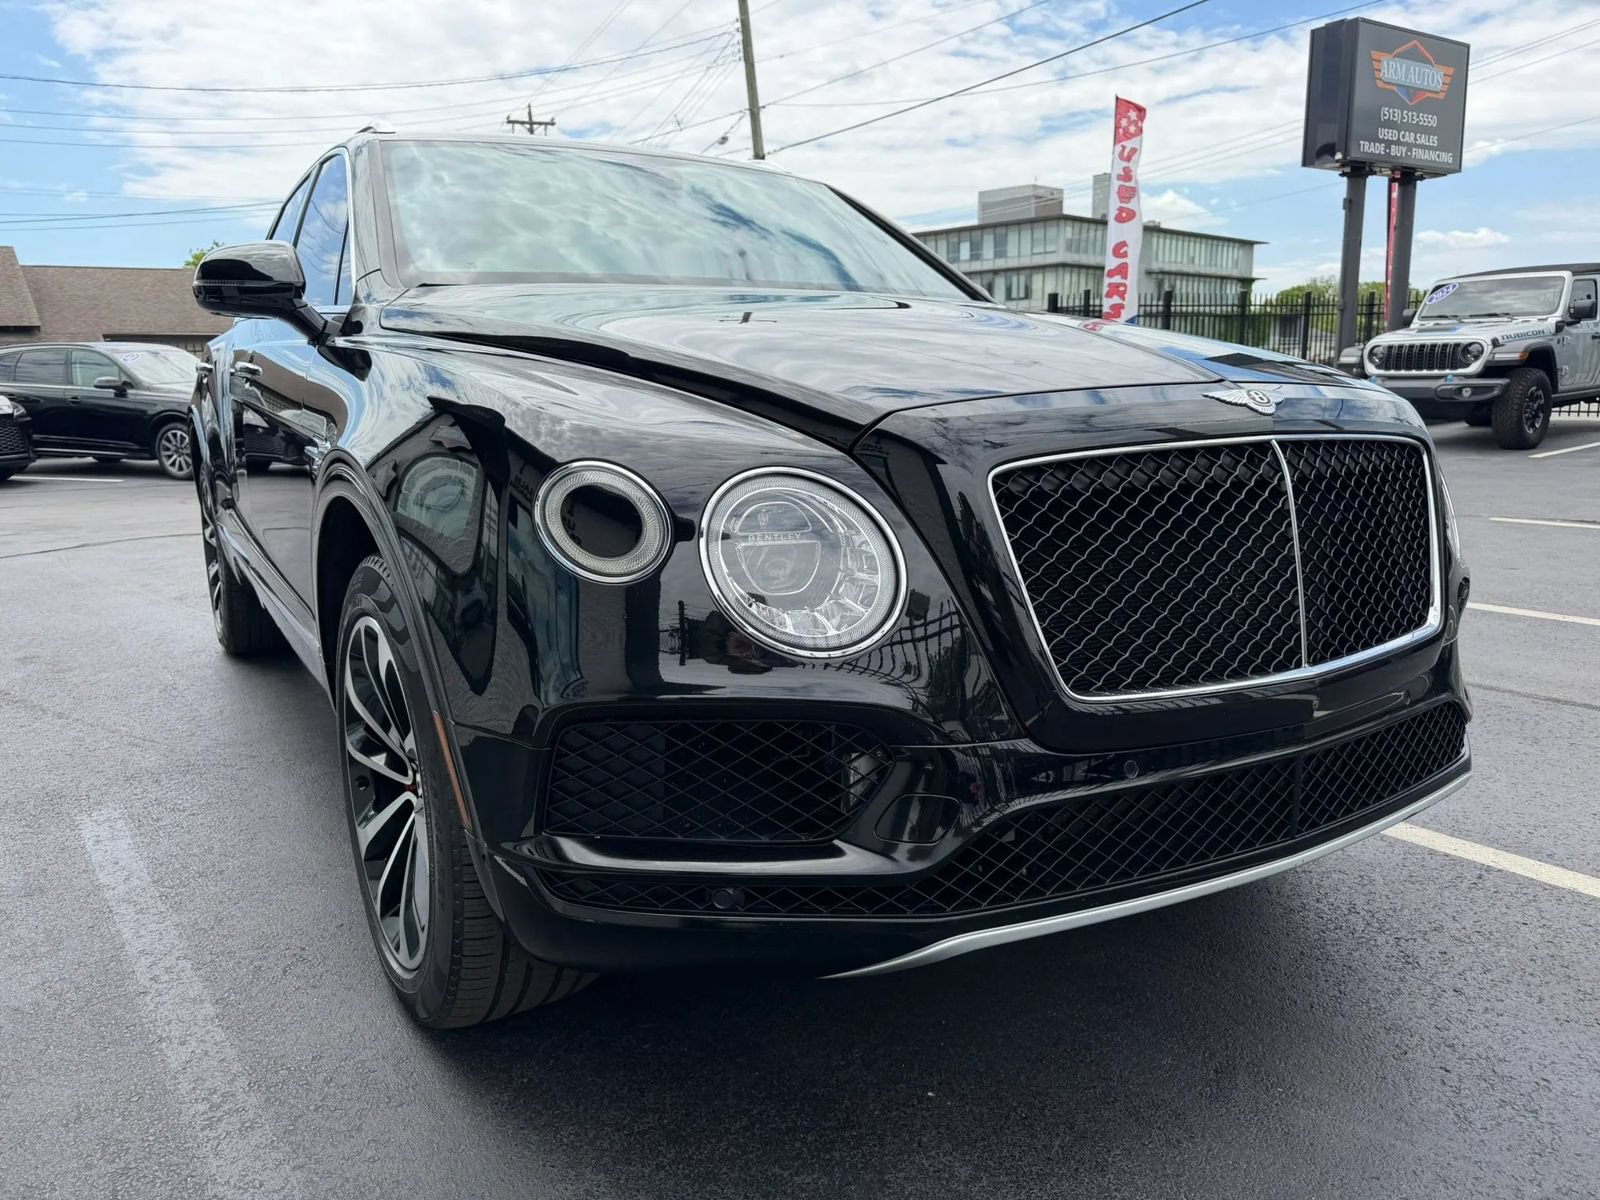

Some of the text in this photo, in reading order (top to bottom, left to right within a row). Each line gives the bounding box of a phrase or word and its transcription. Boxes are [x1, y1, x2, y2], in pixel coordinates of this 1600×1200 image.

[1381, 60, 1444, 88] ARM AUTOS
[1381, 106, 1438, 127] (513) 513-5550
[1378, 127, 1438, 147] USED CAR SALES
[1360, 140, 1386, 155] TRADE
[1391, 144, 1407, 157] BUY
[1412, 147, 1453, 164] FINANCING
[1103, 144, 1137, 318] USED CARS
[1501, 329, 1545, 340] RUBICON
[749, 533, 800, 541] BENTLEY
